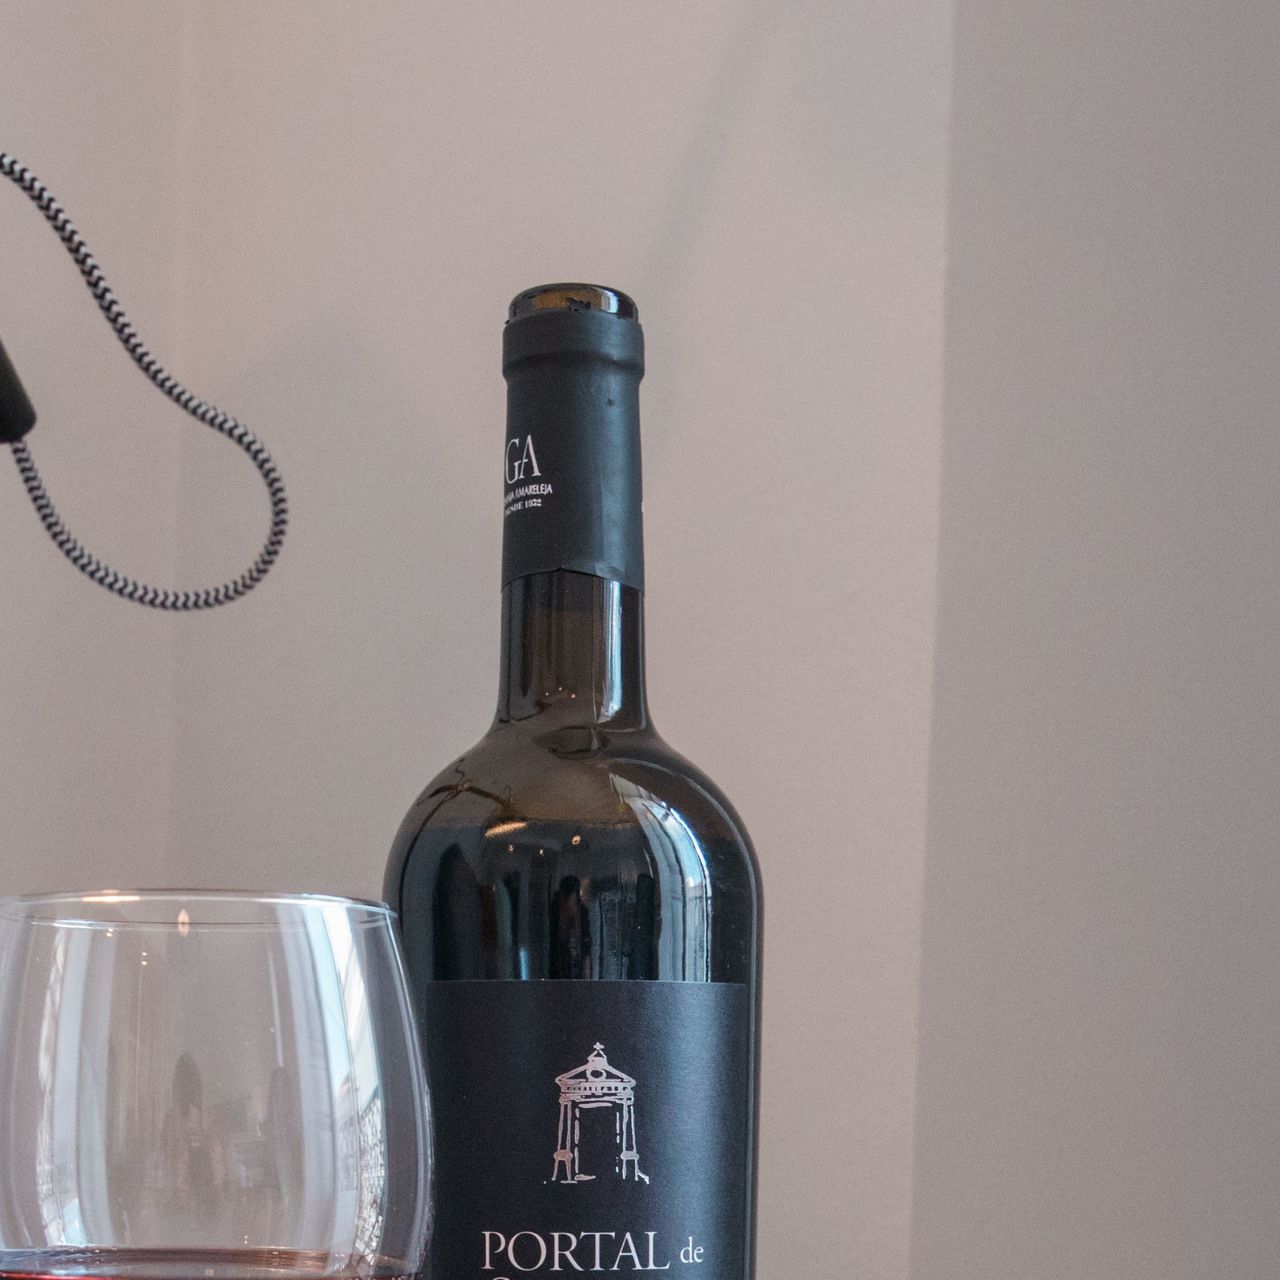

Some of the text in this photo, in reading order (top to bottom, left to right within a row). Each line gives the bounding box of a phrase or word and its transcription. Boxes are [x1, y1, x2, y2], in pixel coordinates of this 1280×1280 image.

[505, 434, 542, 484] GA
[481, 1231, 704, 1272] PORTAL de
